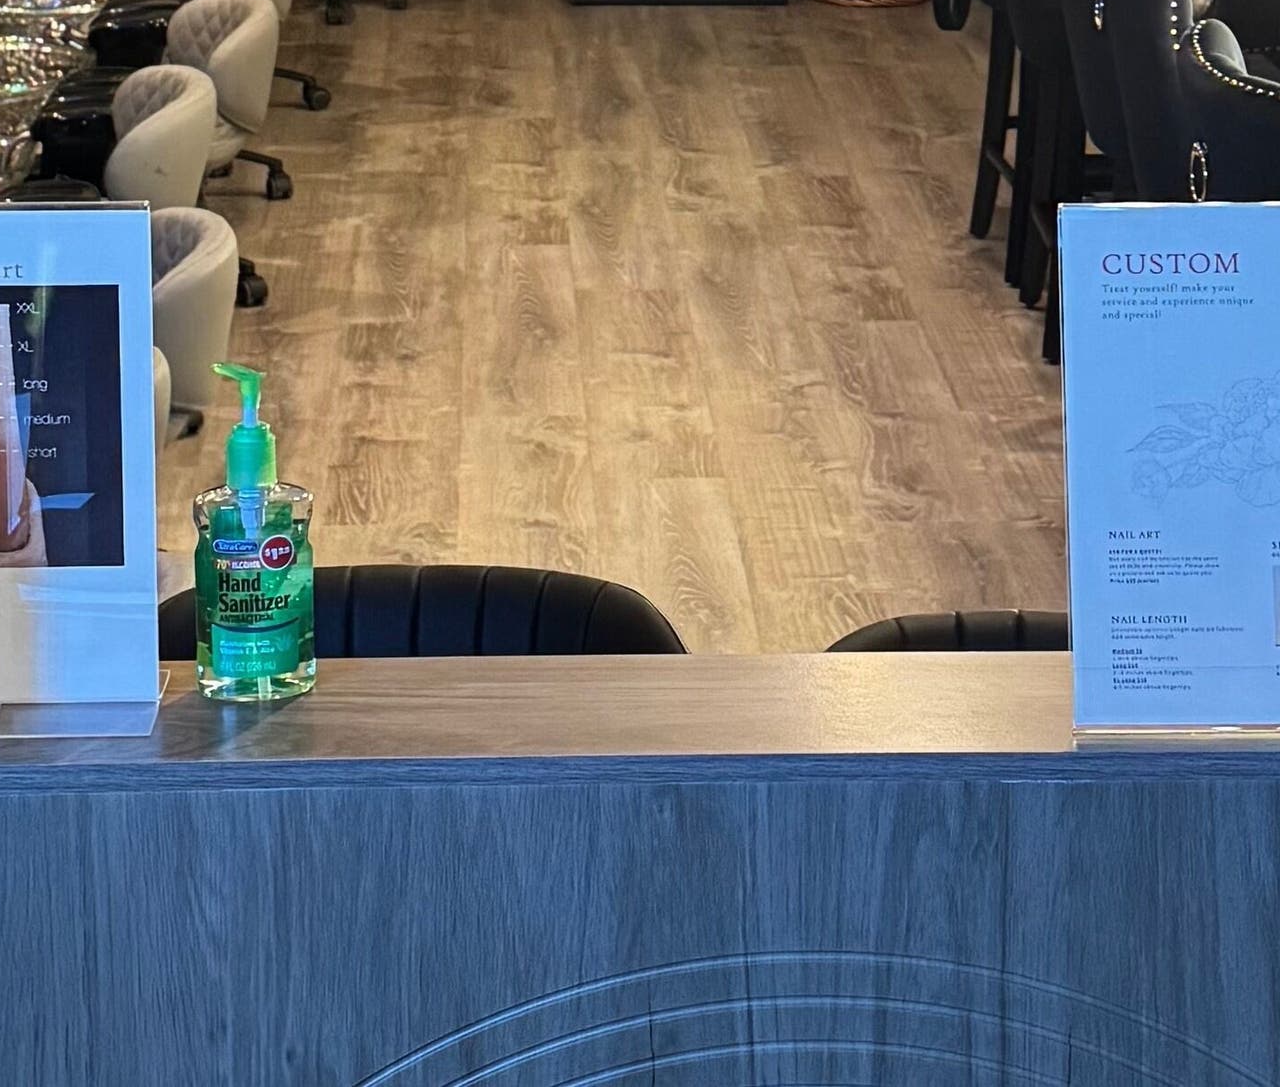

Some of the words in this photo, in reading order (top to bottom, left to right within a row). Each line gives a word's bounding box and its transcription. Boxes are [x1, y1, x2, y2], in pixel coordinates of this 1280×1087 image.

[1102, 252, 1240, 275] CUSTOM
[1181, 283, 1208, 293] make
[1212, 284, 1235, 295] your
[16, 302, 40, 314] XXL
[1101, 297, 1137, 307] service
[1140, 297, 1158, 306] and
[1162, 298, 1215, 308] experience
[1218, 298, 1254, 308] unique
[1102, 310, 1120, 320] and
[18, 340, 34, 353] XL
[23, 378, 48, 393] long
[23, 413, 71, 426] medium
[28, 446, 57, 458] short
[1108, 530, 1136, 540] NAIL
[1138, 530, 1161, 540] ART
[219, 572, 261, 593] Hand
[218, 592, 291, 613] Sanitizer
[1111, 615, 1139, 624] NAIL
[1141, 615, 1188, 624] LENGTH
